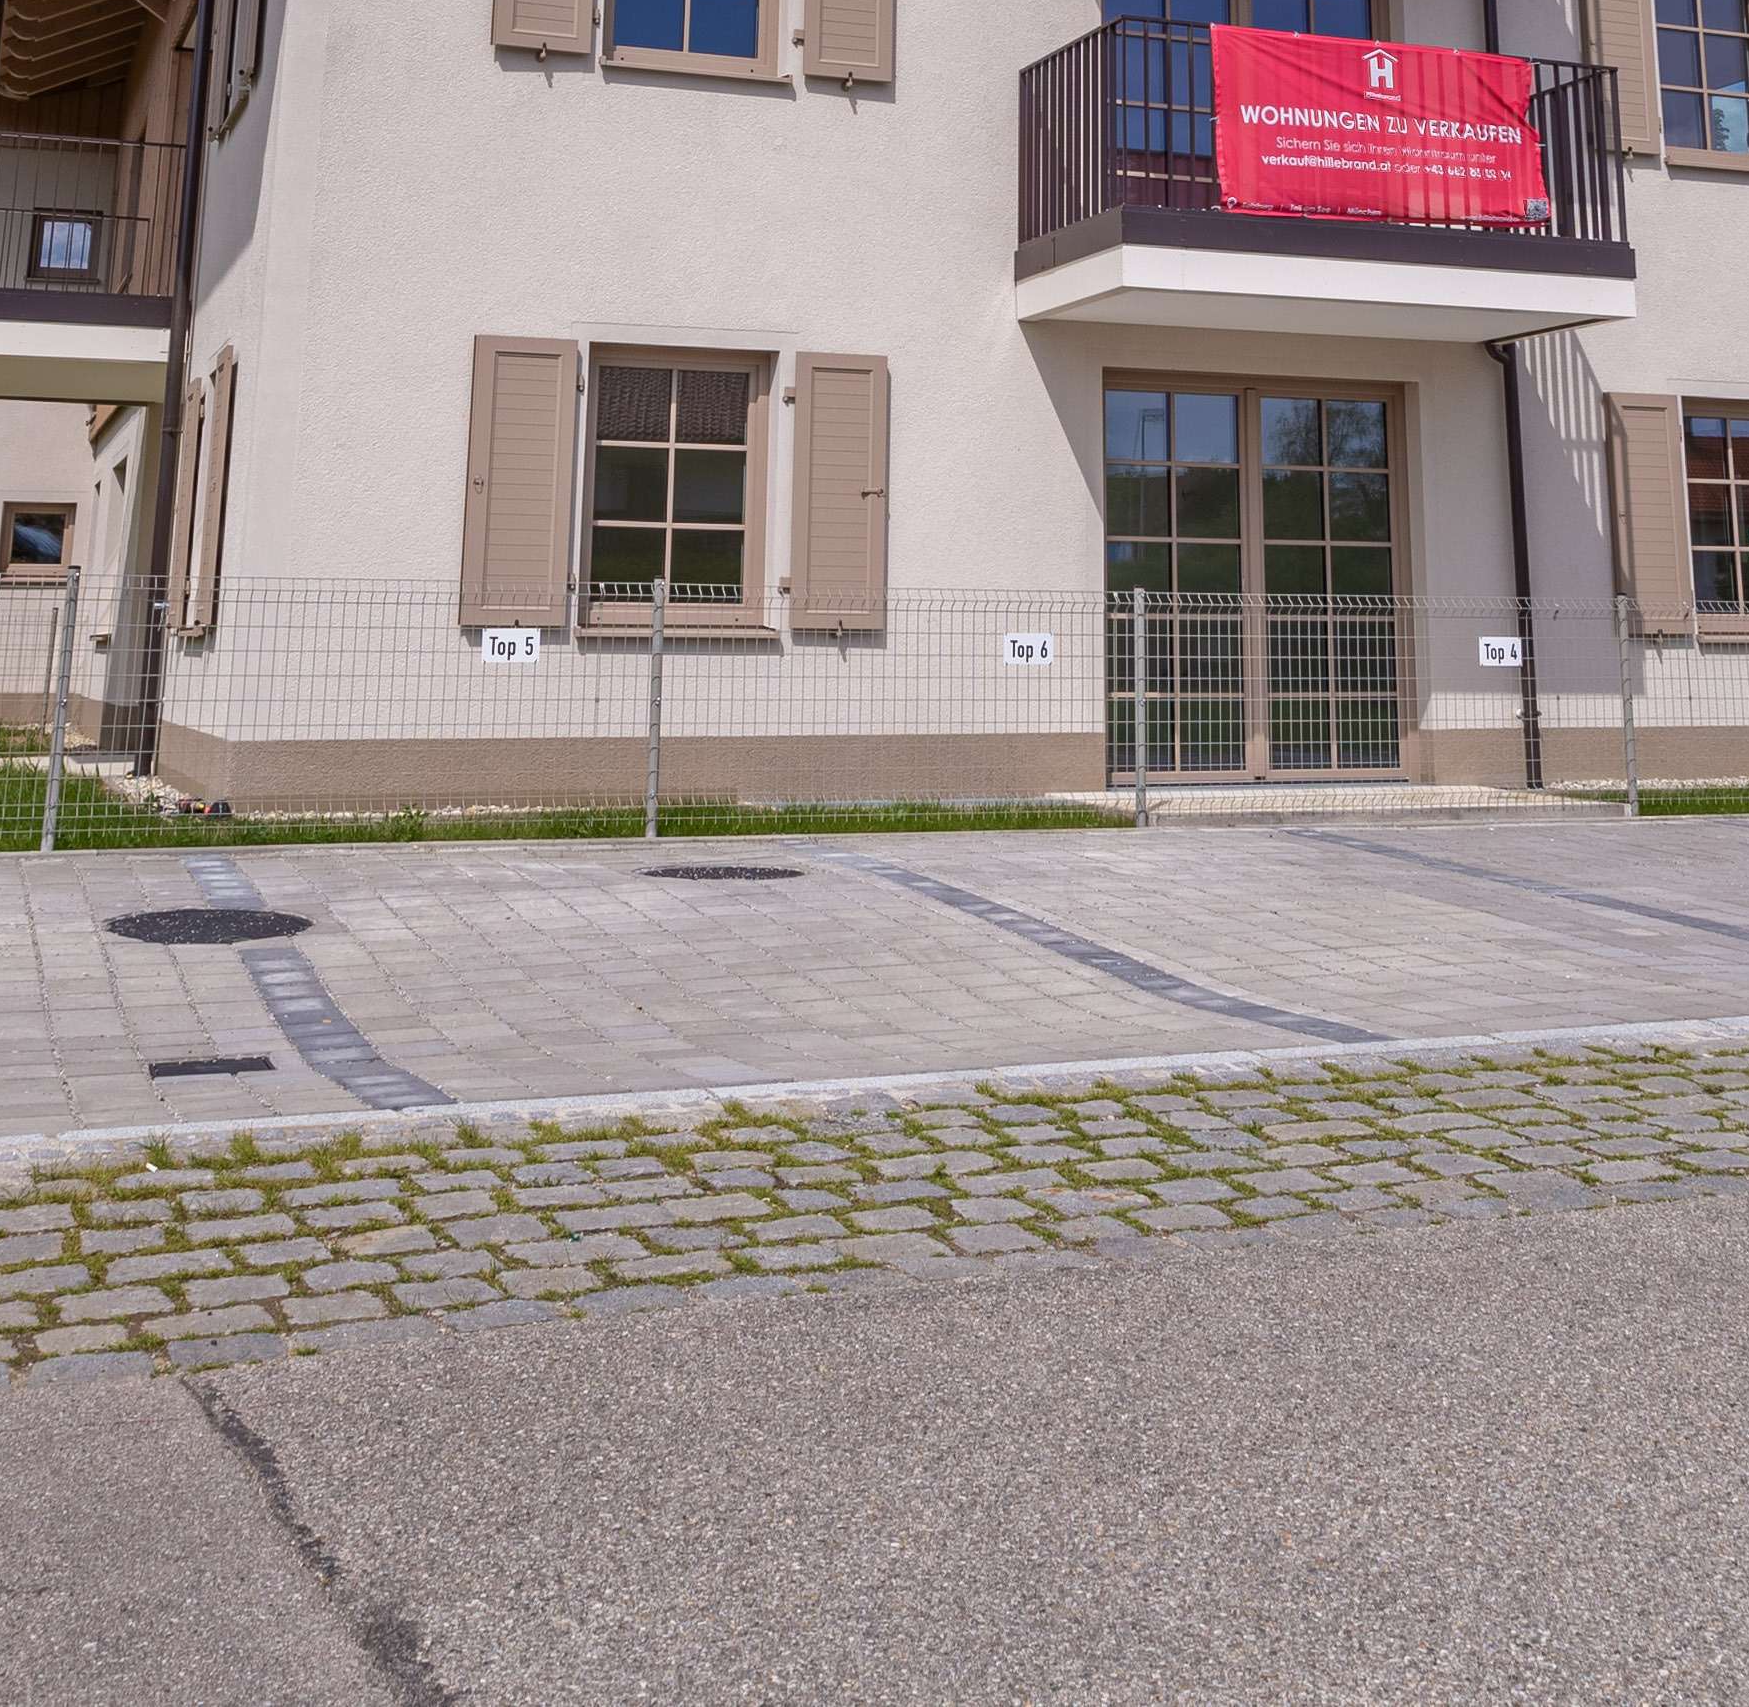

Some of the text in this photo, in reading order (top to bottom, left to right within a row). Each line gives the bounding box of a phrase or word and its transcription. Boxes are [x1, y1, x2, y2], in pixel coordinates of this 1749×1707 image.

[1369, 56, 1394, 89] H
[1240, 104, 1522, 144] WOHNUNGEN ZU VERKAUFEN
[1276, 136, 1321, 151] Sichern
[1323, 139, 1340, 152] Sie
[1343, 140, 1366, 153] sich
[1467, 152, 1497, 164] unter
[1261, 153, 1391, 173] verkauf@hillebrand.at
[1394, 162, 1420, 174] oder
[489, 636, 534, 661] Top 5
[1010, 639, 1048, 663] Top 6
[1484, 643, 1518, 664] Top 4
